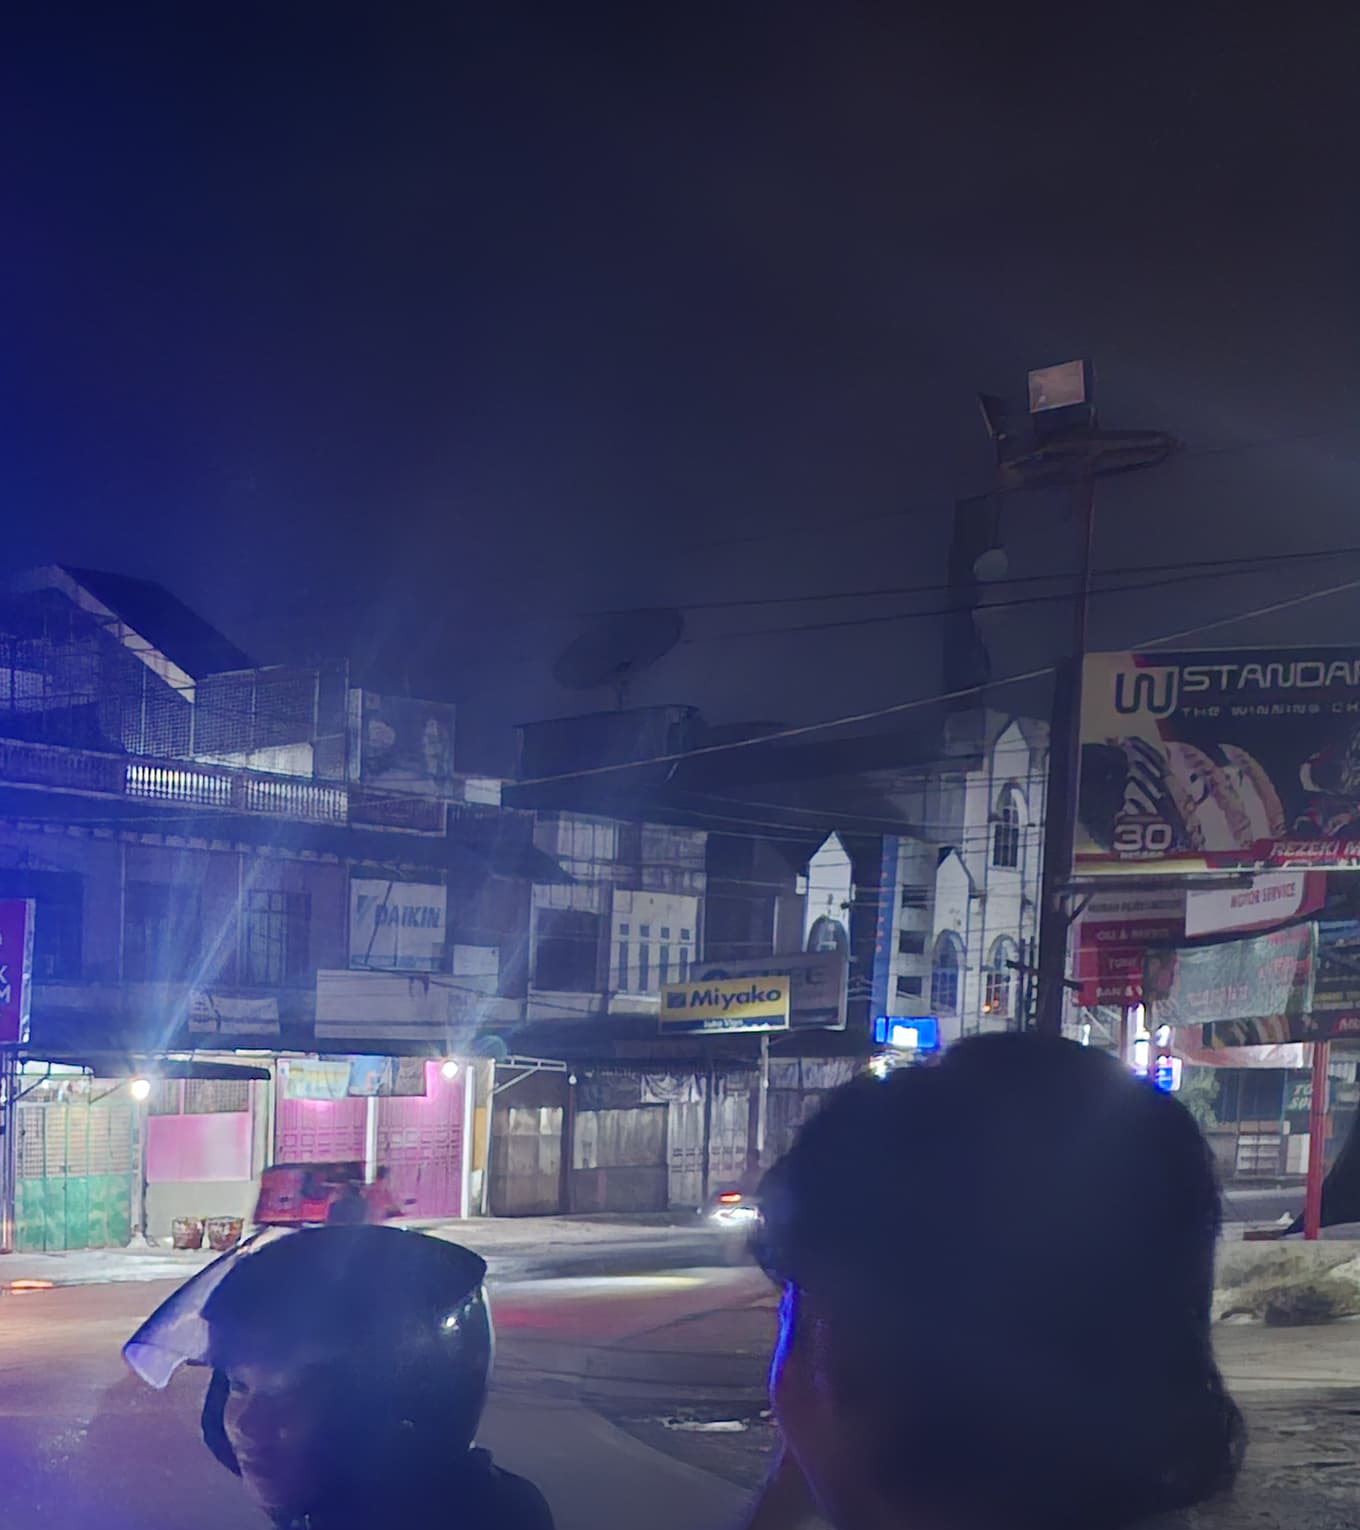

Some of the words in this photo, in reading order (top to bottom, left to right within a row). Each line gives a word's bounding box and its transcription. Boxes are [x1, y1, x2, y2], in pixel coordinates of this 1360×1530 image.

[1182, 706, 1221, 718] THE
[1231, 703, 1321, 717] WINNING
[1113, 823, 1172, 851] 30
[1270, 840, 1340, 858] REZEKI
[375, 904, 442, 929] DAIKIN
[690, 984, 782, 1010] Miyako
